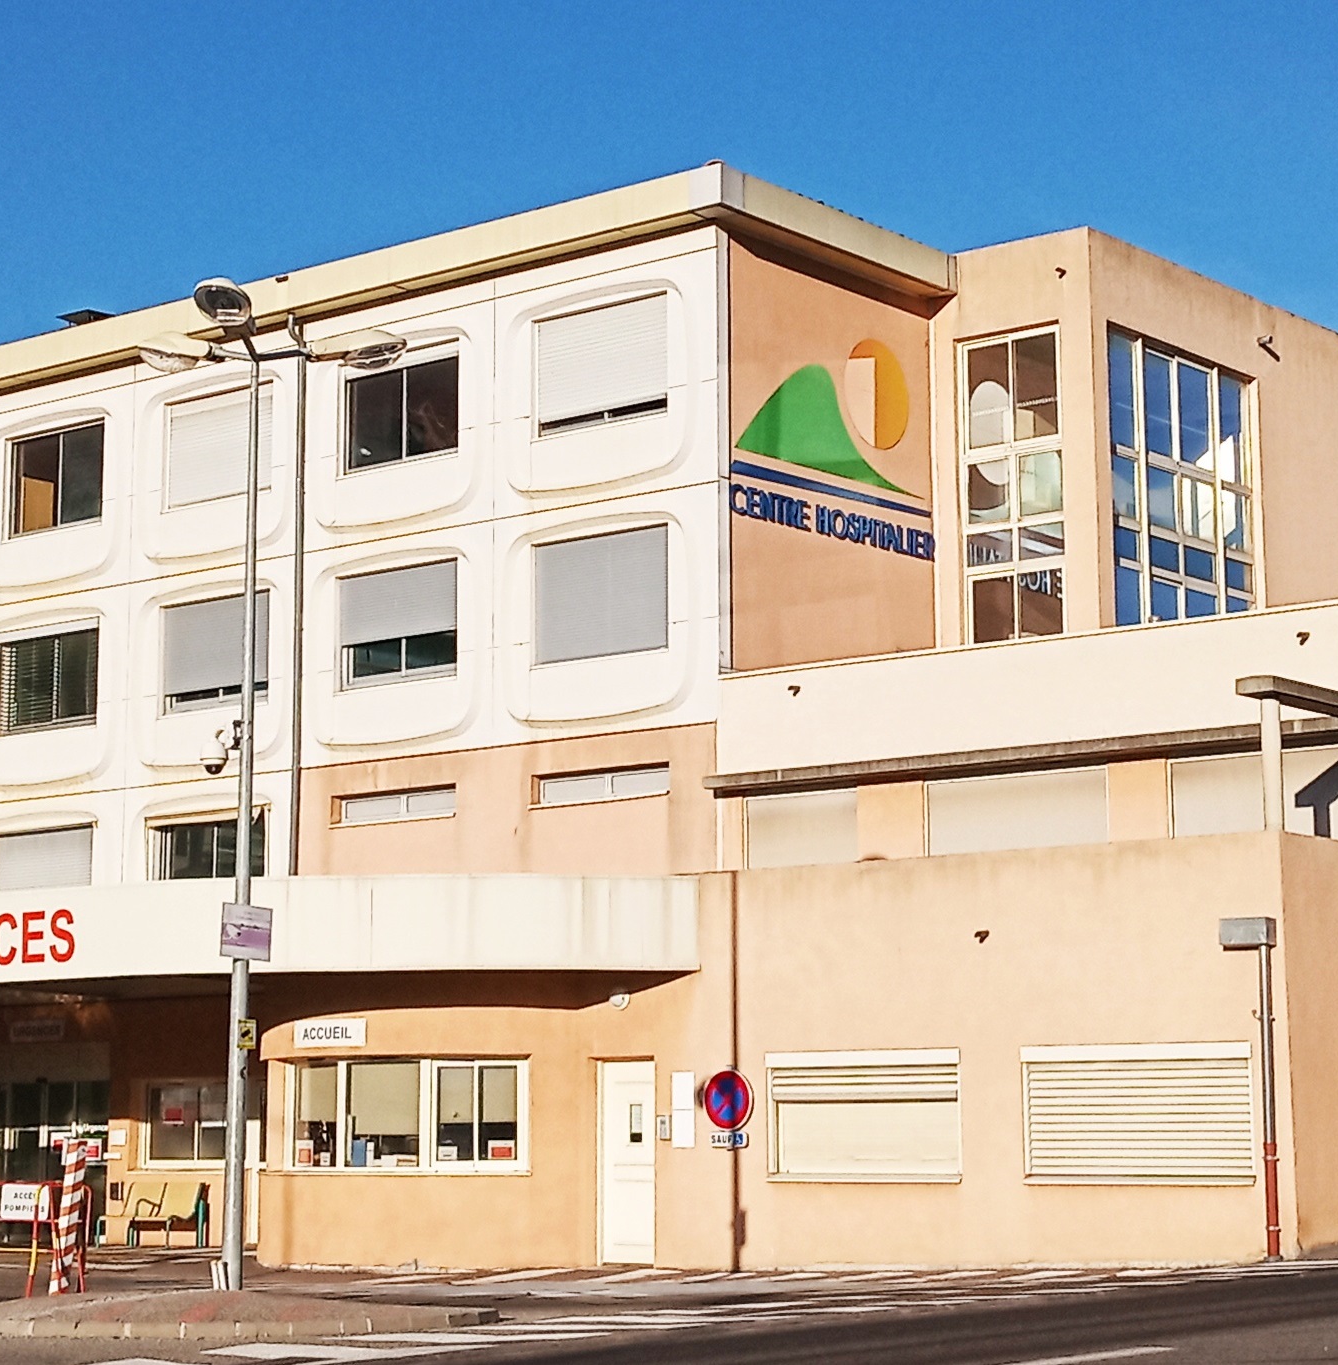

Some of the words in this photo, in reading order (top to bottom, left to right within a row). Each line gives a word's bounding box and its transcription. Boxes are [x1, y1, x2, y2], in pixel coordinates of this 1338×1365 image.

[729, 484, 811, 532] CENTRE
[815, 503, 936, 562] HOSPITALIER
[302, 1026, 352, 1040] ACCUEIL
[711, 1134, 733, 1144] SAUF
[4, 1203, 45, 1214] POMPIES
